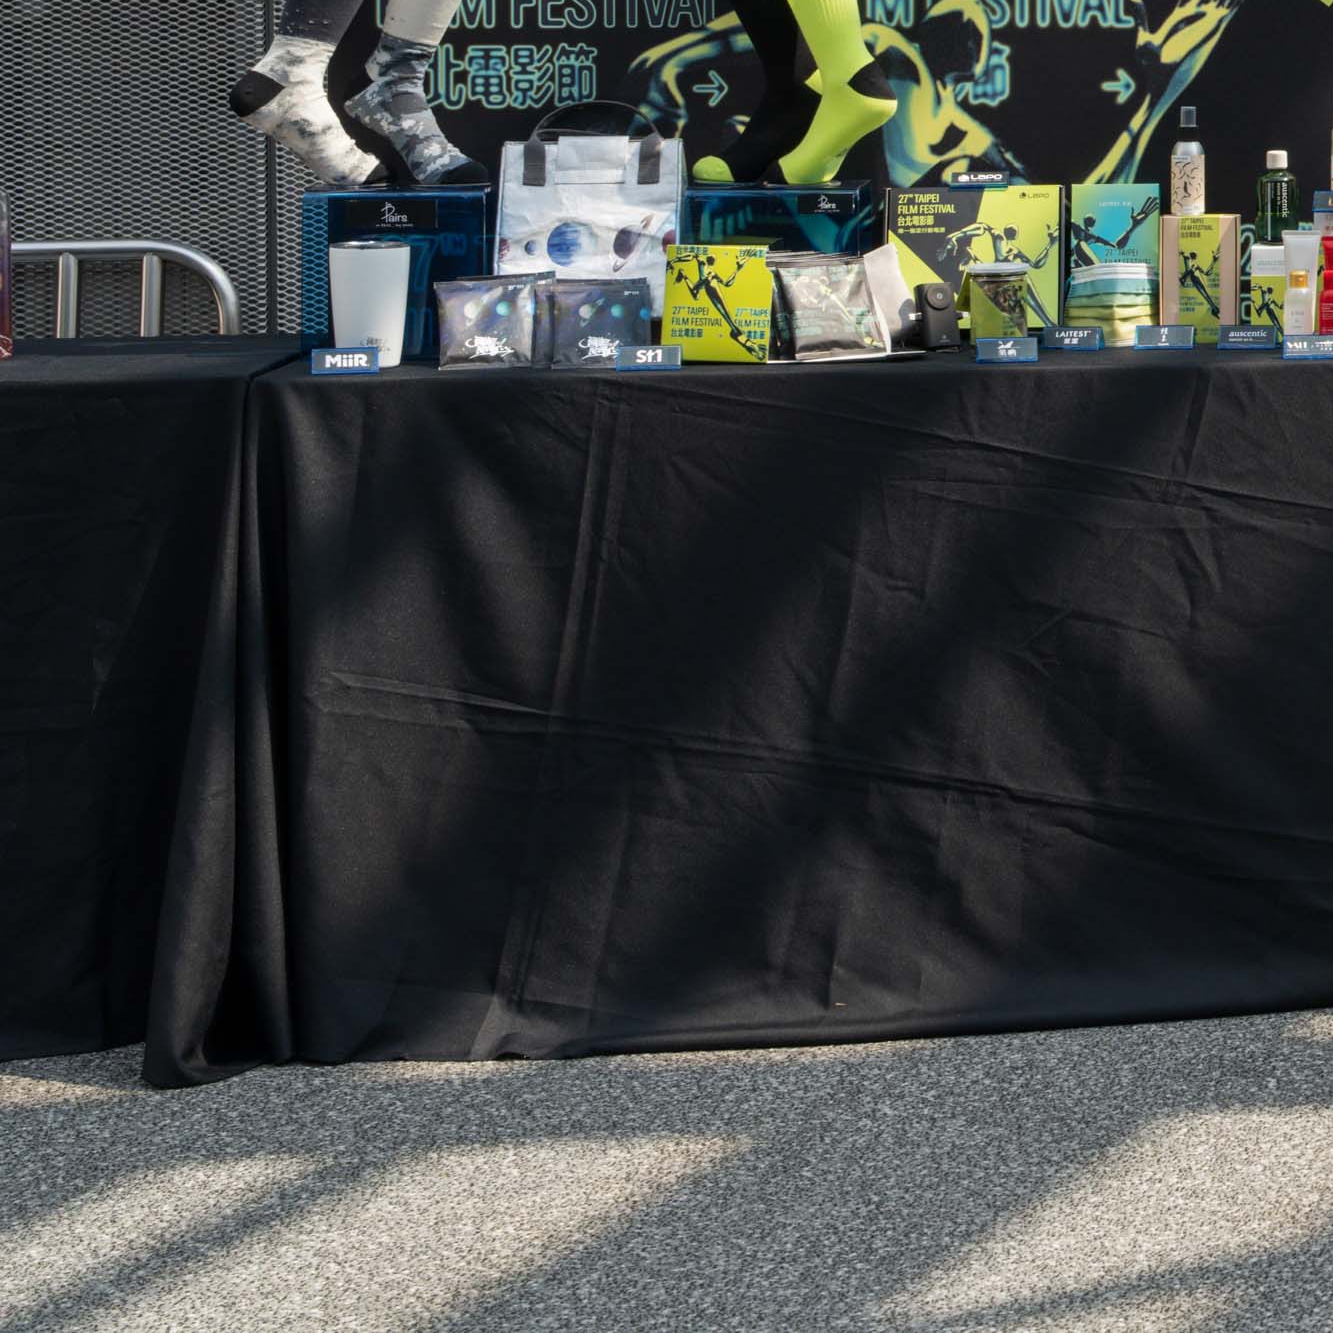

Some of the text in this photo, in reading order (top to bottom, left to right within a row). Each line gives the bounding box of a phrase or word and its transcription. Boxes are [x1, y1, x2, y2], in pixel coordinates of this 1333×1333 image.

[427, 42, 598, 111] 北電影節
[324, 353, 368, 368] MiiR
